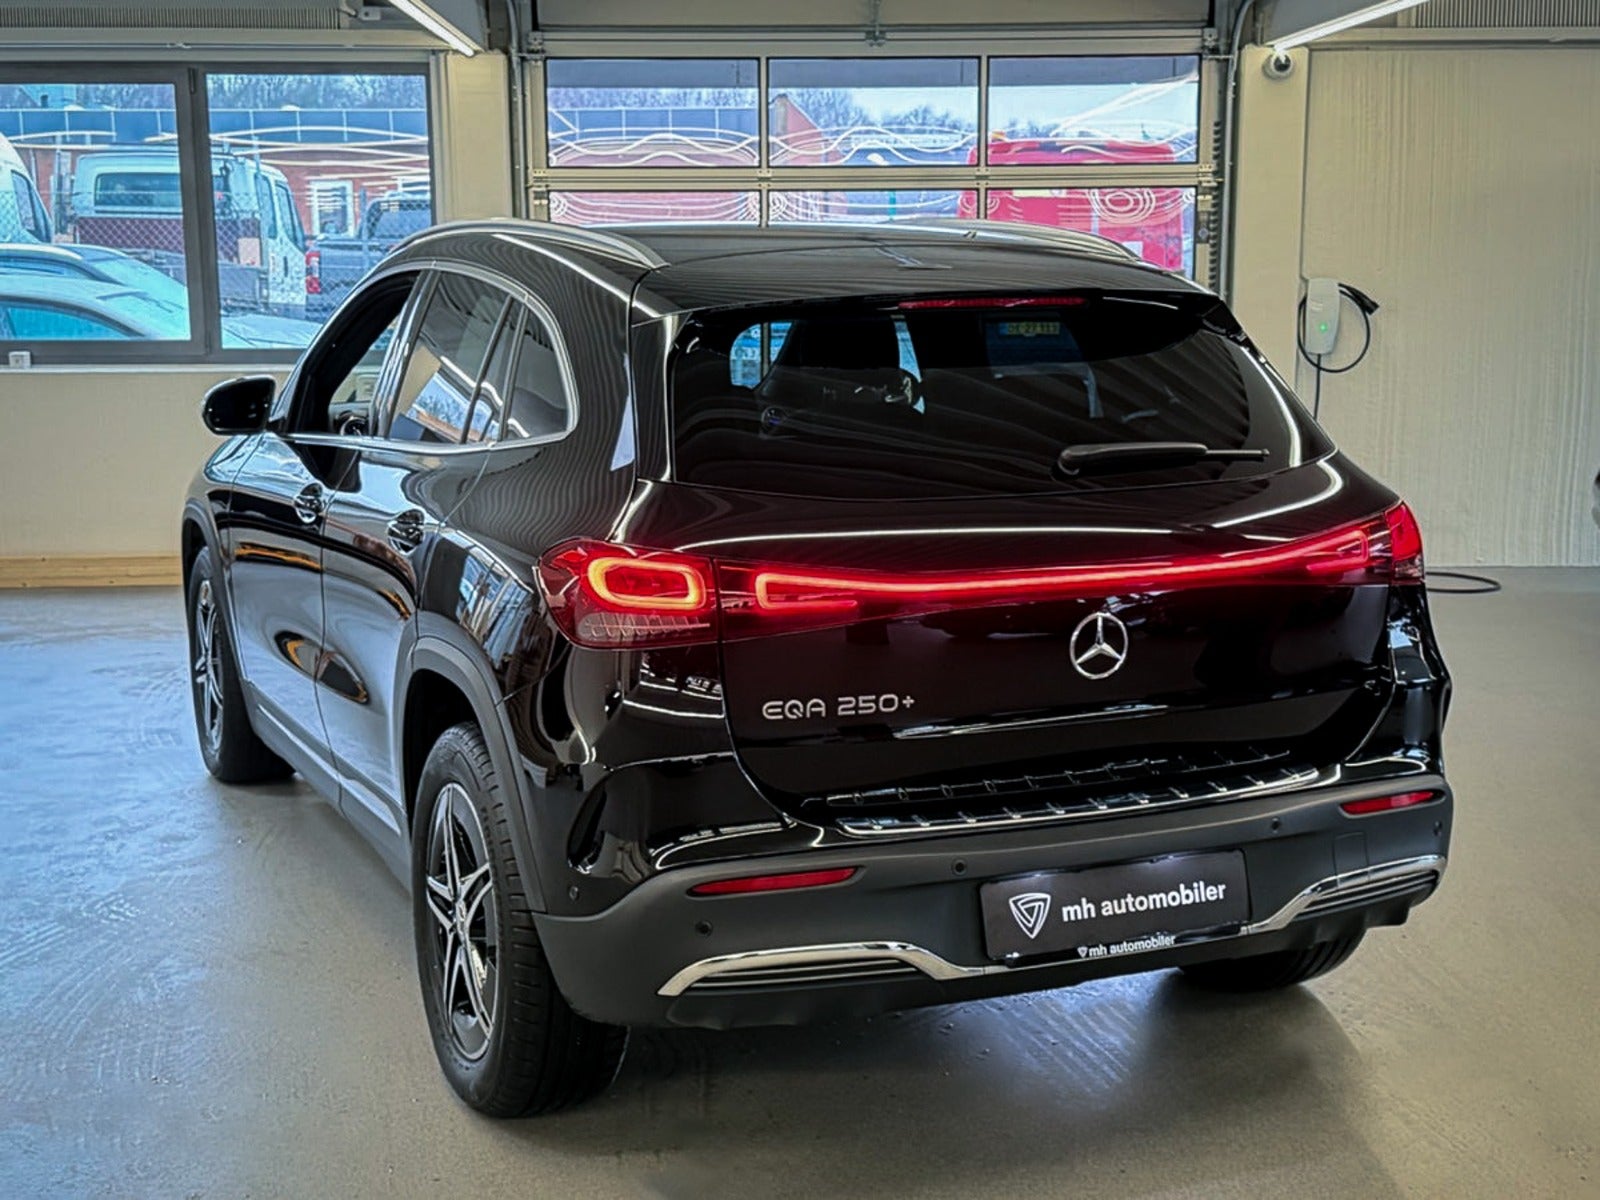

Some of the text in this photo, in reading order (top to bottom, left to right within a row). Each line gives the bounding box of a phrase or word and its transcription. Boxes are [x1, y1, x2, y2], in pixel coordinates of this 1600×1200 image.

[762, 693, 915, 720] EQA 250+
[1061, 880, 1226, 922] mh automobiler
[1088, 934, 1175, 957] mh automobiler
